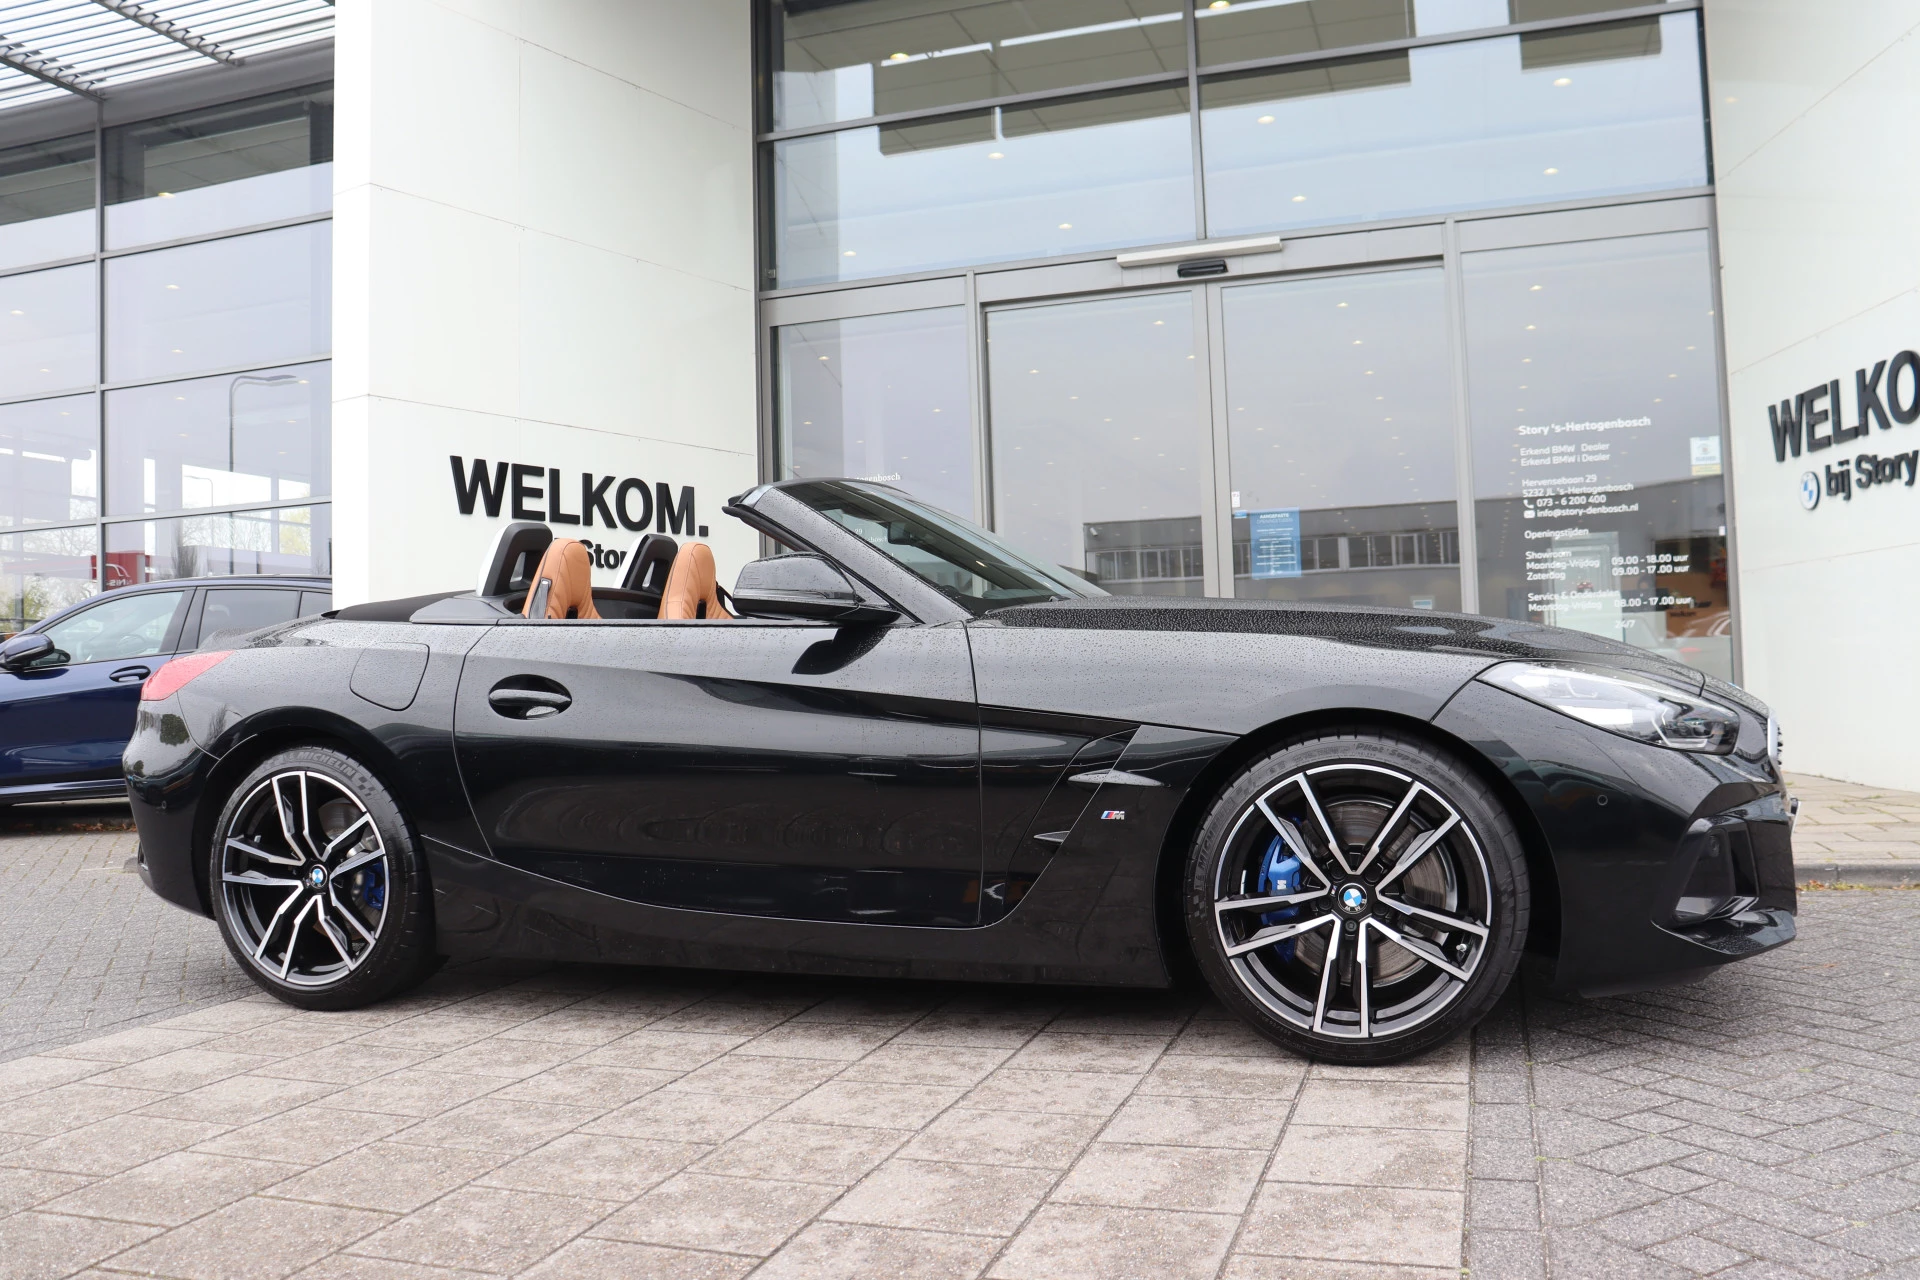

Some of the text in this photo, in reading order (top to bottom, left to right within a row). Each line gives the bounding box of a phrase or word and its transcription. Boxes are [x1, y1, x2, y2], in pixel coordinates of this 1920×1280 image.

[1768, 350, 1920, 463] WELKO
[1519, 416, 1651, 436] Story 's-Hertogenbosch
[1520, 442, 1610, 456] Erkend BMW Dealer
[1521, 457, 1551, 467] Erkend
[1552, 455, 1576, 464] BMW
[1581, 453, 1610, 462] Dealer
[1585, 474, 1597, 483] 29
[1825, 450, 1919, 502] bij Story
[450, 455, 709, 537] WELKOM.
[1522, 488, 1544, 498] 5232
[1545, 488, 1555, 497] JL
[1536, 498, 1553, 507] 073
[1560, 497, 1567, 506] 6
[1568, 496, 1586, 505] 200
[1588, 494, 1606, 503] 400
[1537, 503, 1639, 518] info@story-denbosch.nl
[1524, 528, 1589, 540] Openingstijden
[1525, 551, 1572, 560] Showroom
[1526, 559, 1600, 570] Maandag-Vrijdag
[1611, 556, 1639, 565] 09.00
[1646, 554, 1672, 563] 18.00
[1673, 554, 1689, 562] uur
[1526, 571, 1566, 580] Zaterdag
[1612, 566, 1639, 576] 09.00
[1646, 565, 1672, 574] 17.00
[1527, 593, 1559, 602] Service
[1561, 591, 1568, 600] &
[1614, 598, 1641, 607] 08.00
[1648, 596, 1674, 605] 17.00
[1615, 619, 1636, 629] 24/7
[297, 752, 357, 779] MICHELIN
